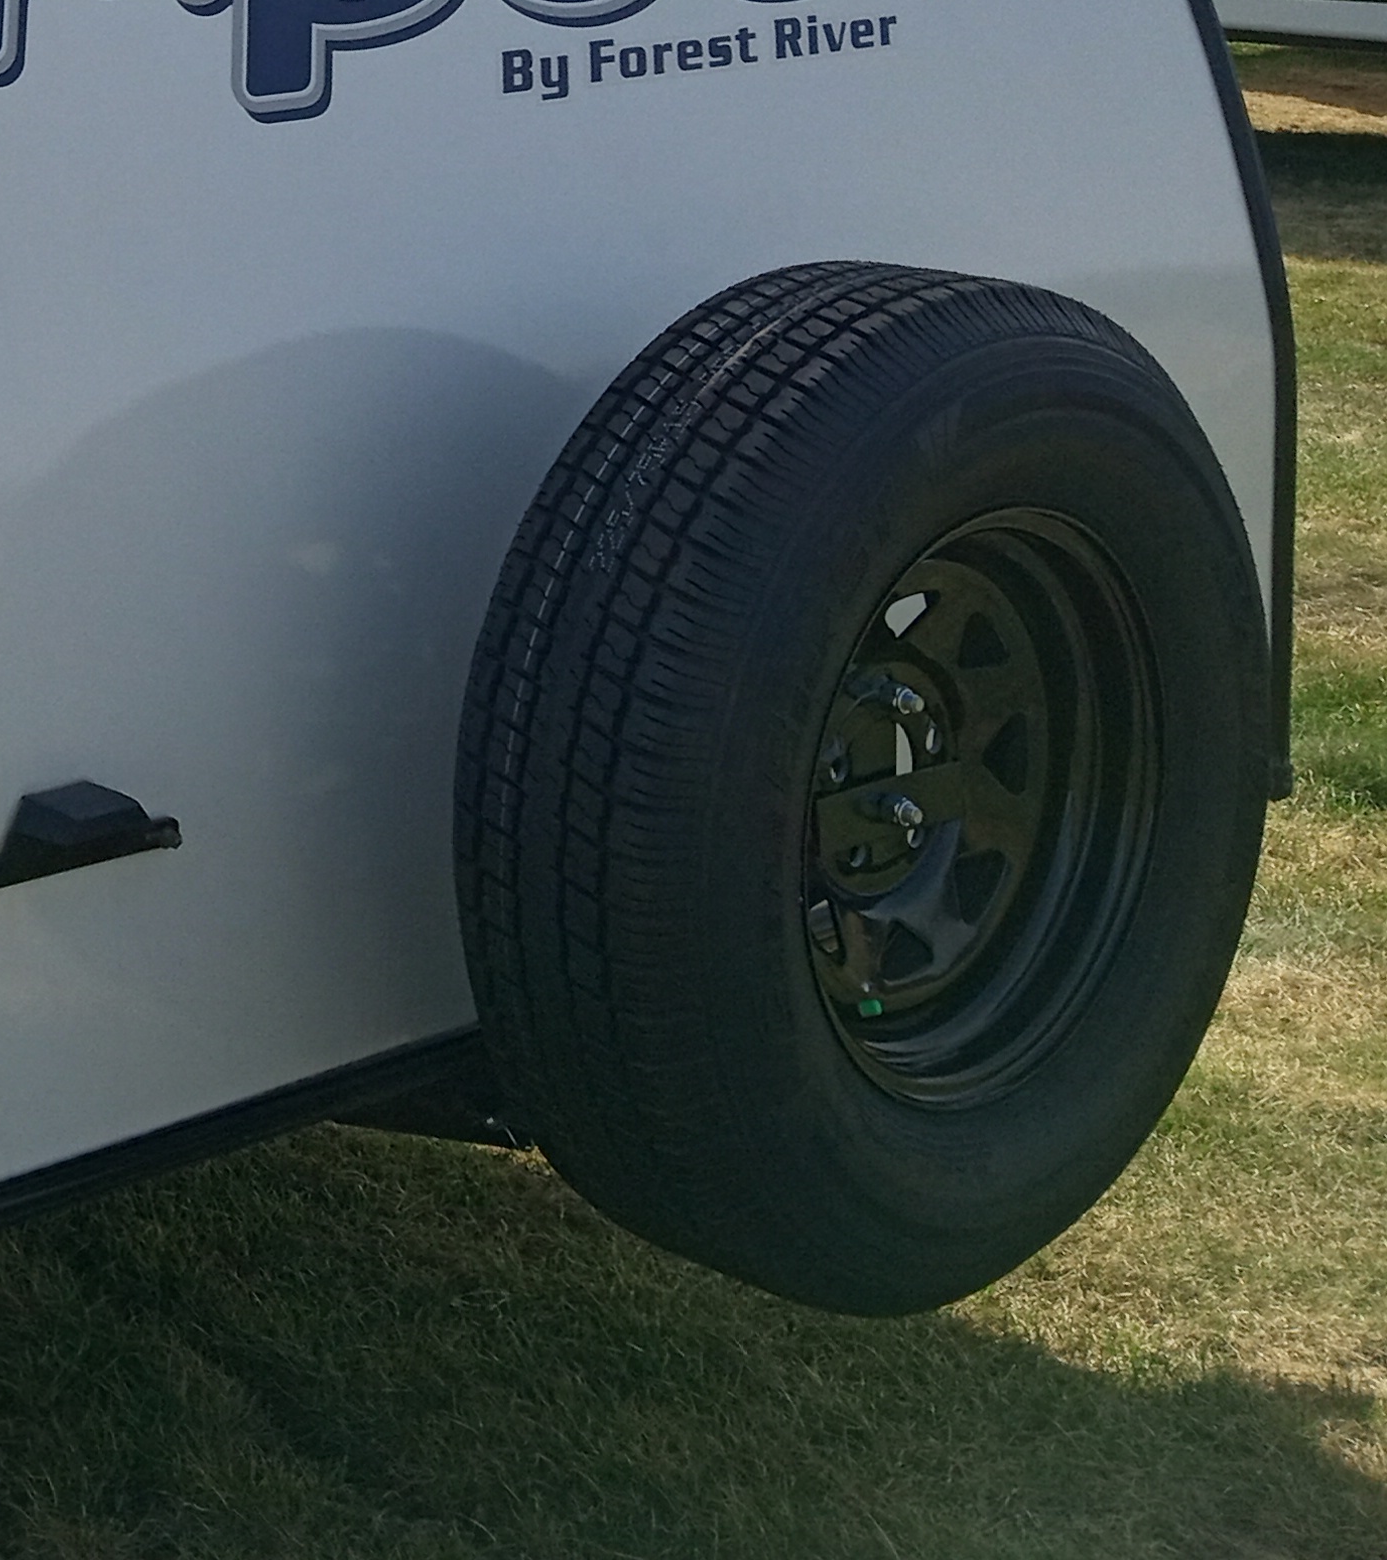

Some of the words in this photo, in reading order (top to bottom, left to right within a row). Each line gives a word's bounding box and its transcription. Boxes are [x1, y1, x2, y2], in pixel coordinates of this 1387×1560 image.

[500, 48, 570, 101] By
[588, 26, 759, 83] Forest
[774, 14, 898, 60] River
